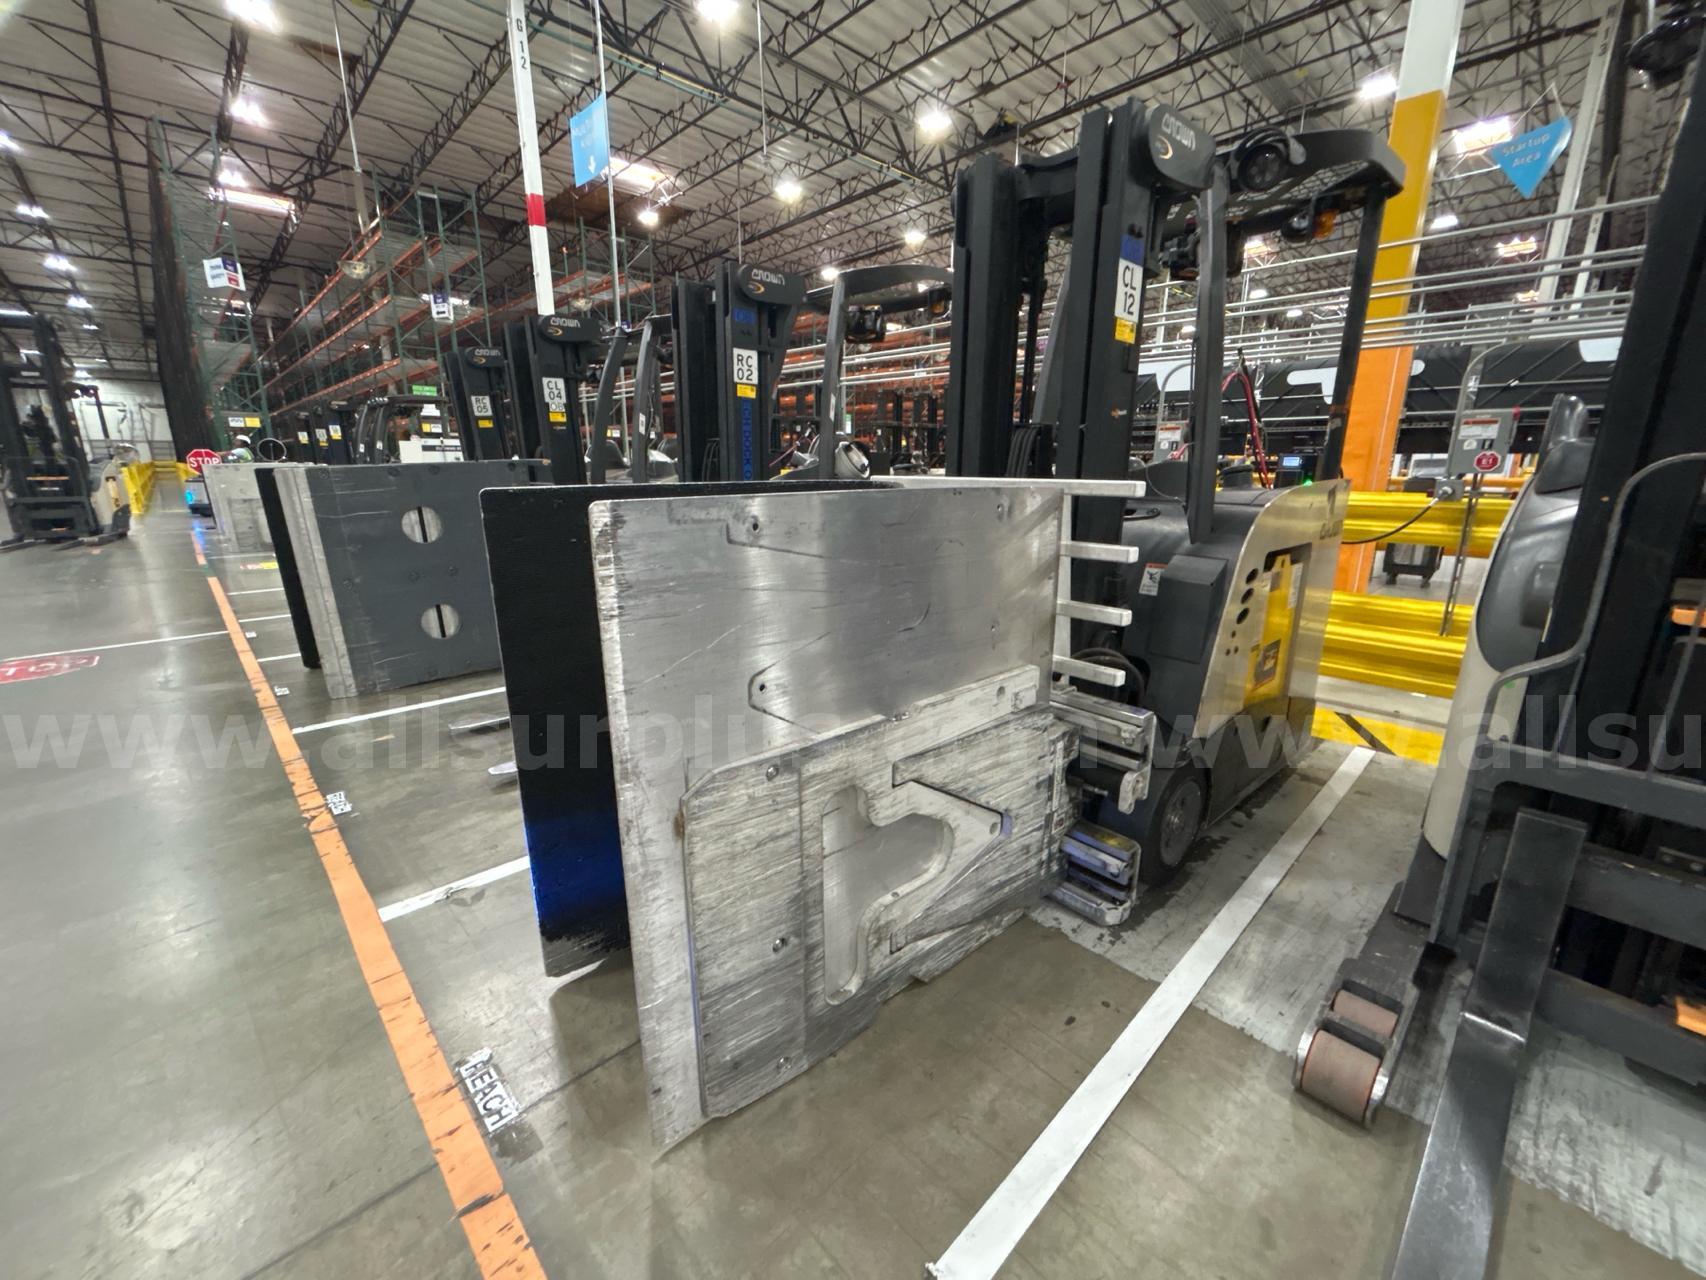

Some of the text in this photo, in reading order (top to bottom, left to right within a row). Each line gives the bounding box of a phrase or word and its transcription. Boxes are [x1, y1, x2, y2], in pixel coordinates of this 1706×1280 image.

[1161, 112, 1196, 151] CROWN
[751, 268, 785, 286] CROWN
[1122, 265, 1137, 292] CL
[1122, 291, 1135, 316] 12
[550, 316, 581, 328] CROWN
[736, 353, 753, 368] RC
[736, 368, 754, 381] 02
[546, 380, 561, 391] CL
[475, 397, 486, 405] RC
[549, 391, 562, 401] 04
[476, 405, 489, 413] 05
[189, 456, 220, 468] STOP
